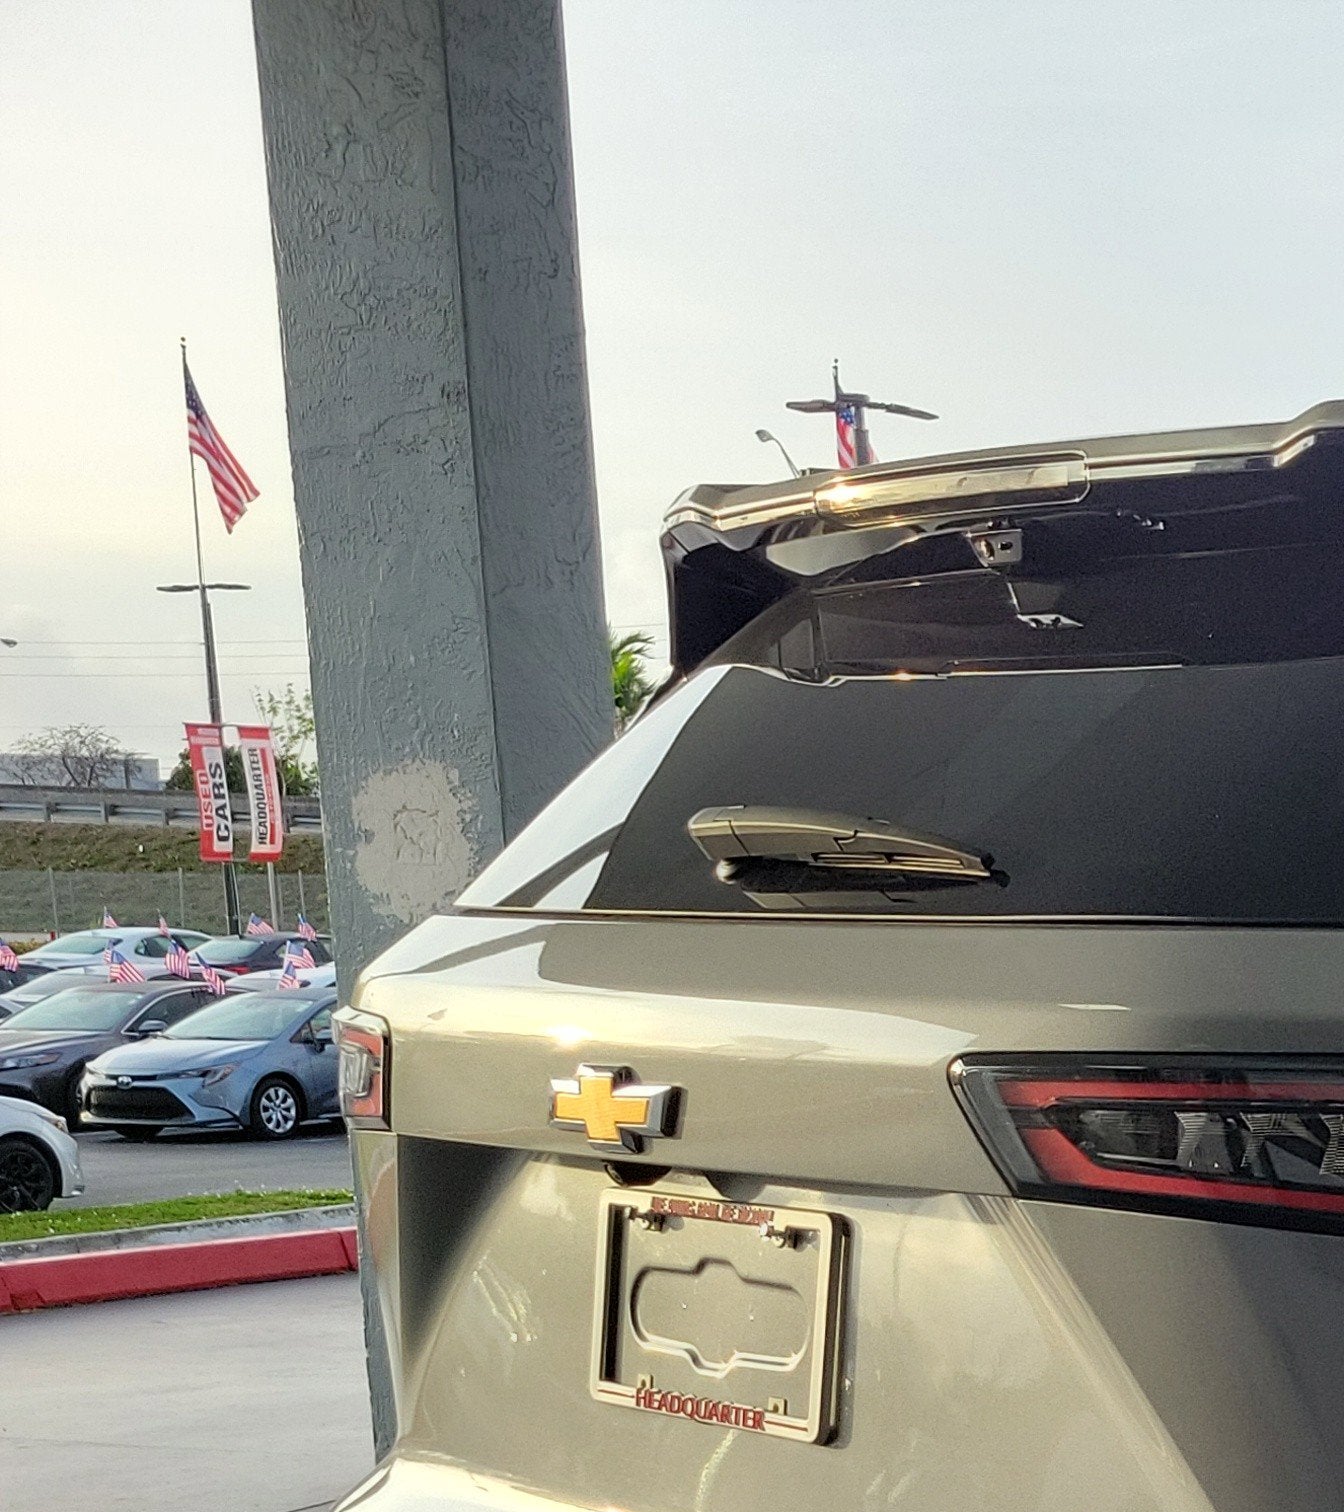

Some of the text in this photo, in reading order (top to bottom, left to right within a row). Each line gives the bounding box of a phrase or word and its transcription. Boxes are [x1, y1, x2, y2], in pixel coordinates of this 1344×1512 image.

[199, 771, 214, 829] USED
[209, 761, 231, 842] CARS
[248, 748, 268, 845] HEADQUARTER
[635, 1388, 766, 1431] HEADQUARTER
